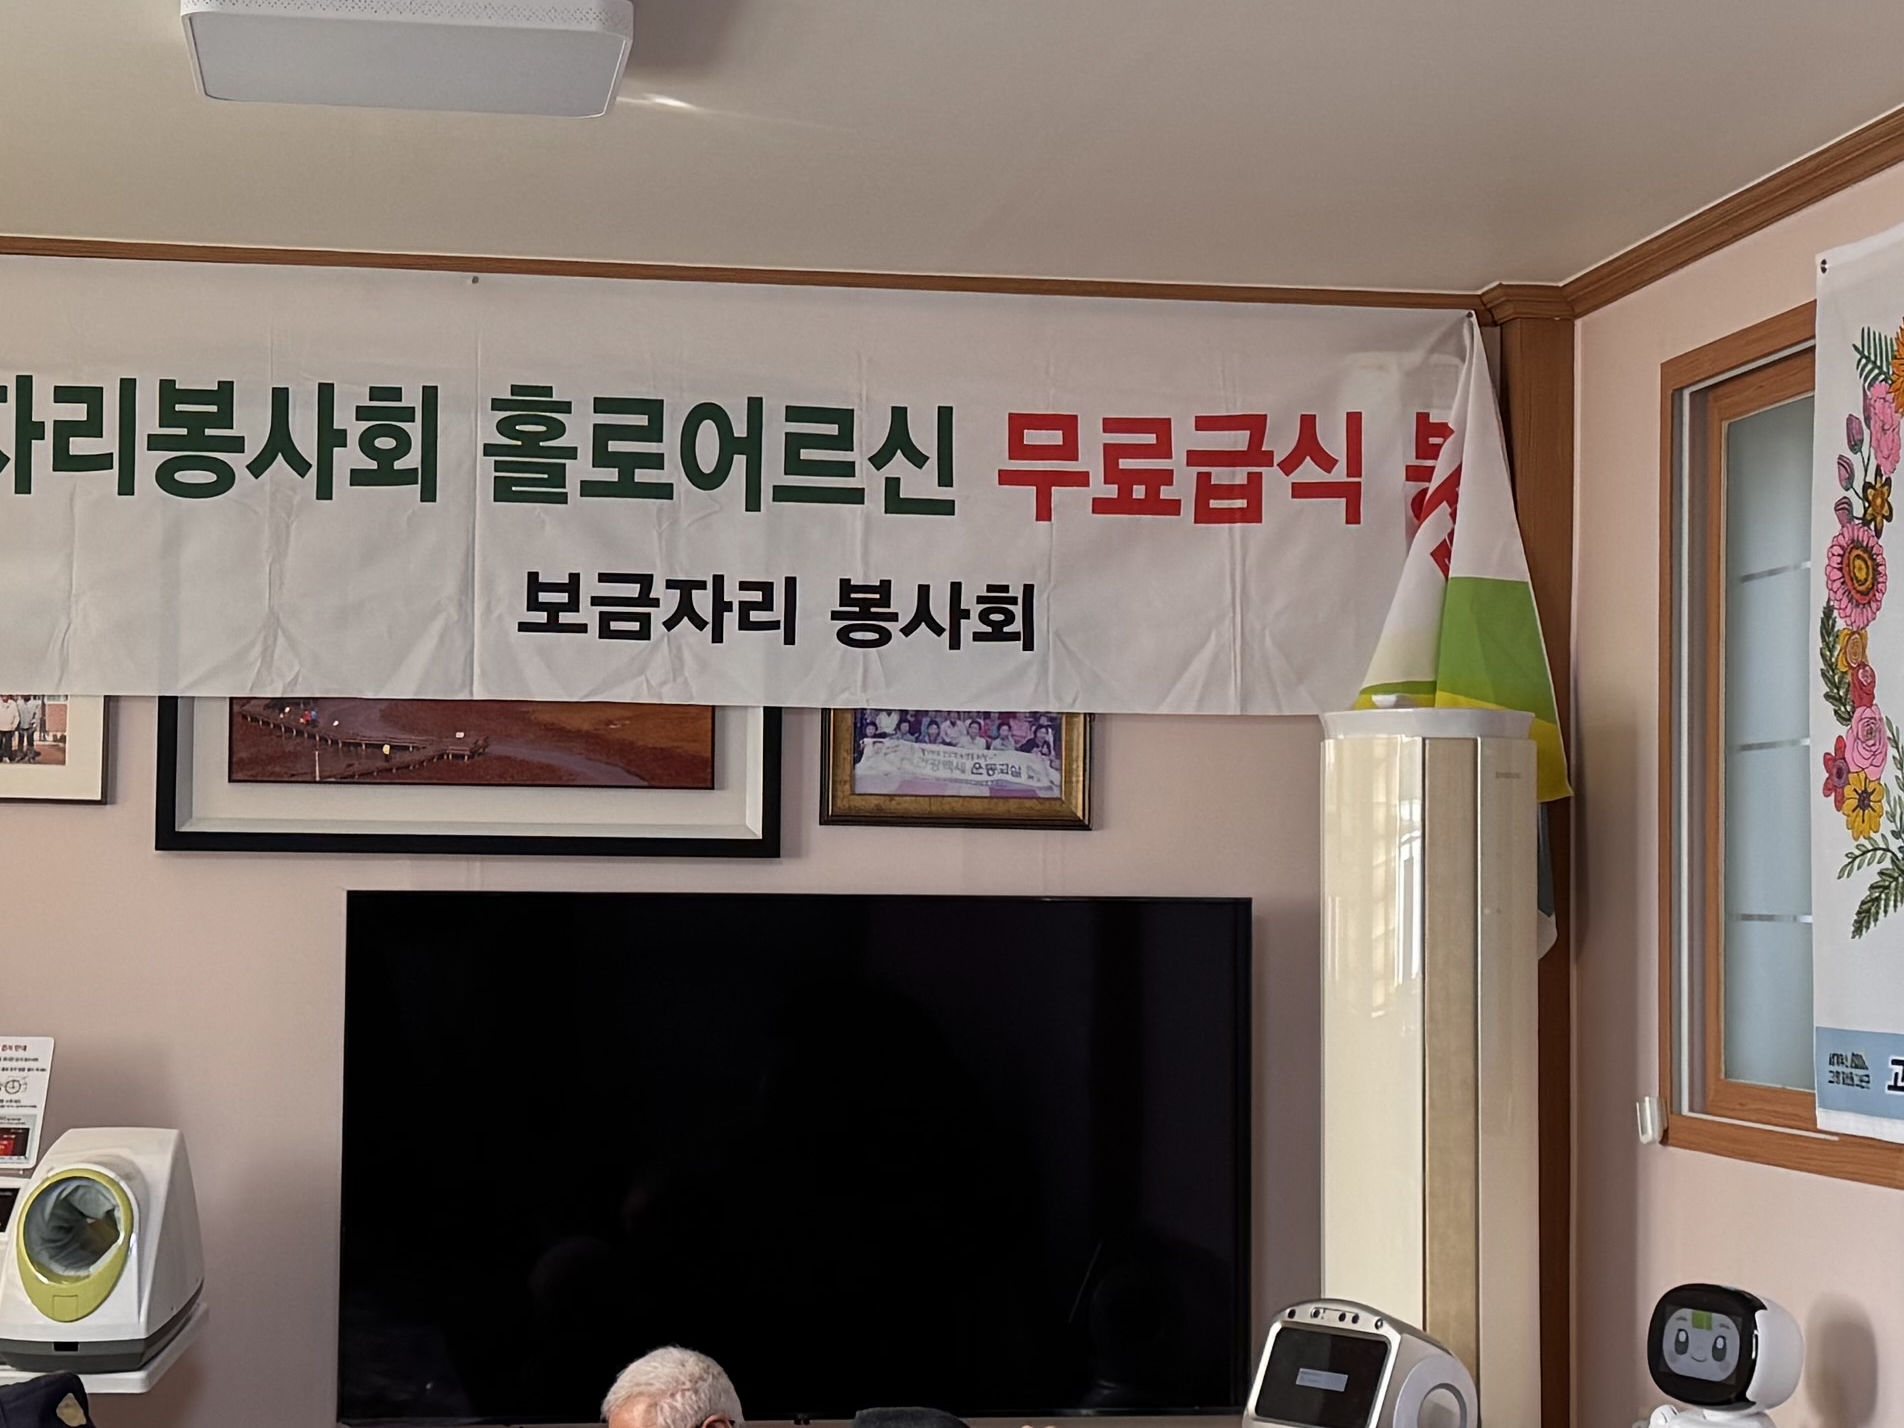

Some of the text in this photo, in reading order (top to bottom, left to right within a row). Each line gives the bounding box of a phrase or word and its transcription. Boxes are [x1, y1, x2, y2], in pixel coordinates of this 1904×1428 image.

[483, 384, 956, 516] 홀로어르신
[997, 411, 1363, 525] 무료급식
[517, 571, 1037, 652] 보금자리 봉사회
